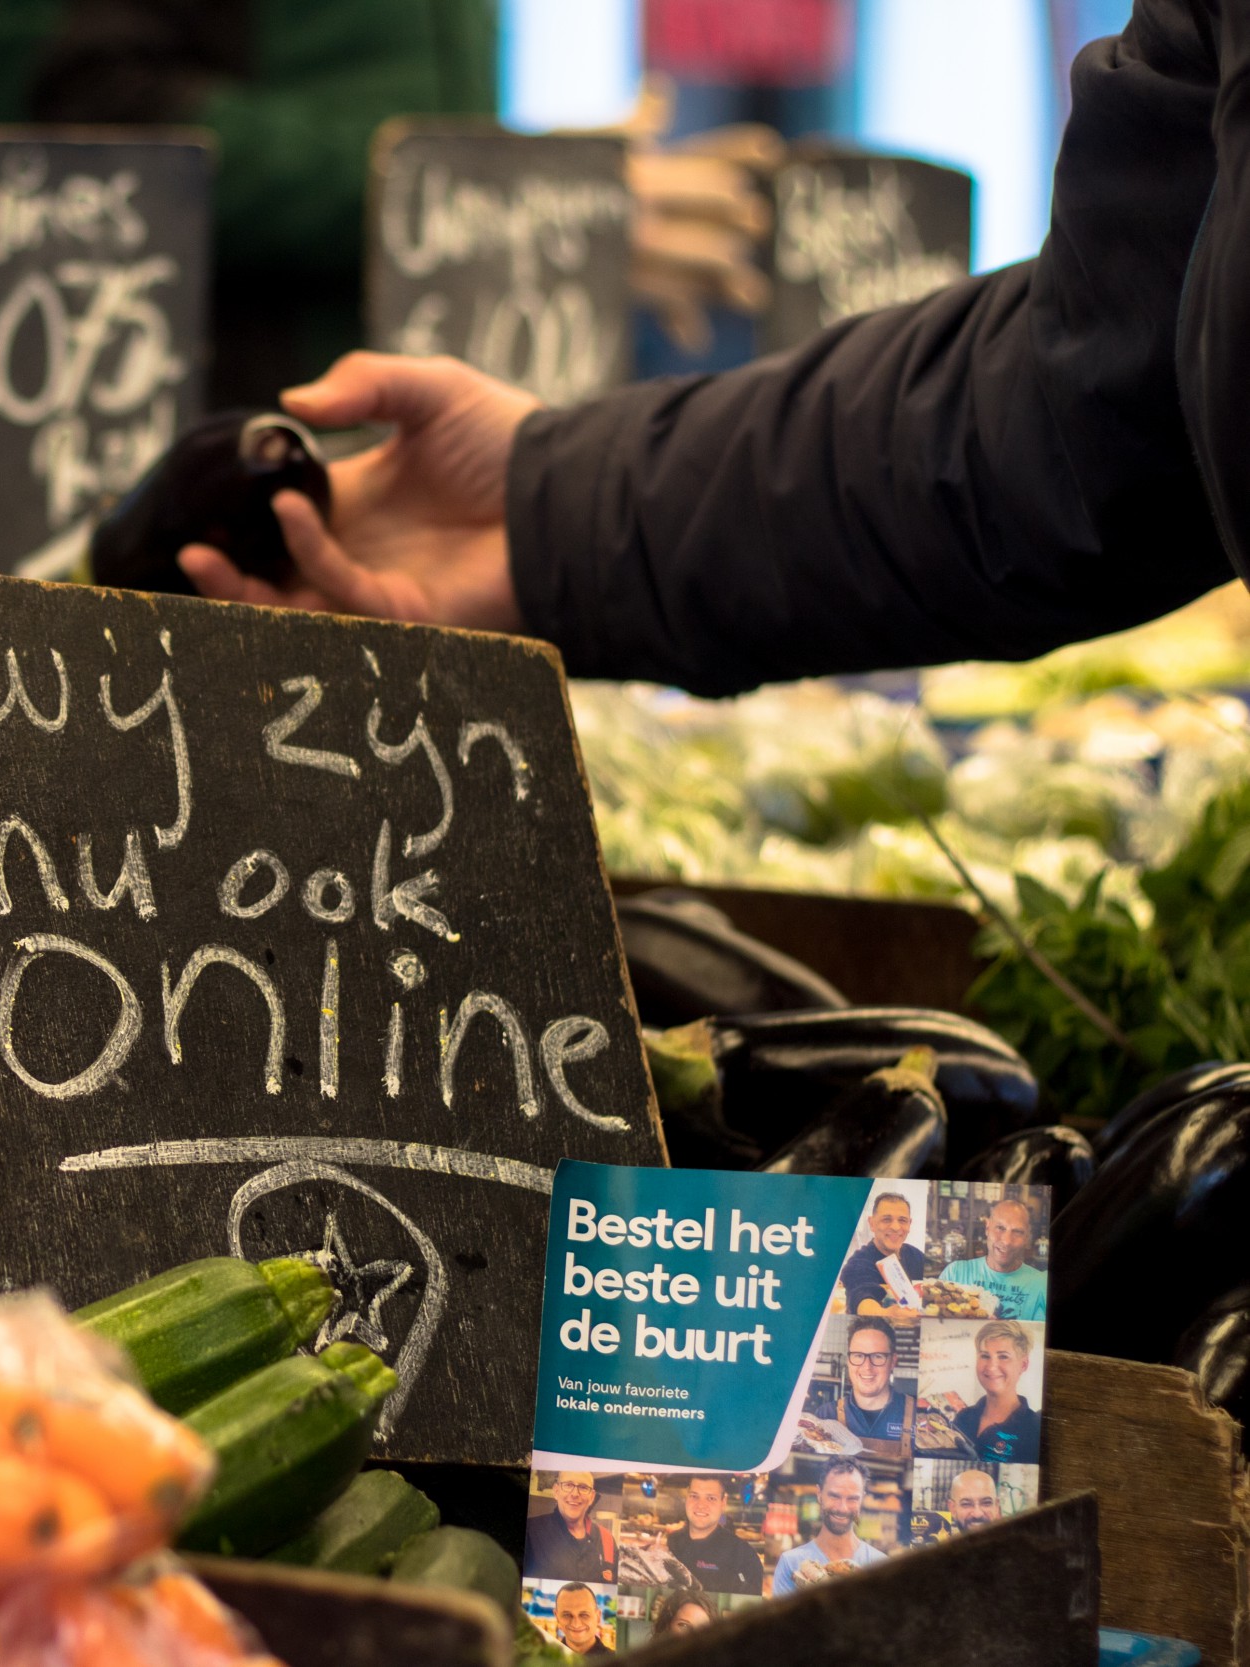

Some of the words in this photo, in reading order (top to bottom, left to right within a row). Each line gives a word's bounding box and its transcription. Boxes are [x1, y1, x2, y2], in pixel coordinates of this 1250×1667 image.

[261, 646, 531, 858] zijn
[218, 818, 461, 942] ook
[566, 1198, 716, 1251] Bestel
[729, 1208, 815, 1257] het
[563, 1251, 700, 1305] beste
[715, 1264, 782, 1310] uit
[559, 1308, 621, 1354] de
[634, 1313, 773, 1365] buurt
[556, 1395, 600, 1412] lokale
[603, 1402, 705, 1420] ondernemers
[557, 1375, 583, 1391] Van
[586, 1379, 622, 1395] jouw
[625, 1382, 690, 1399] favoriete
